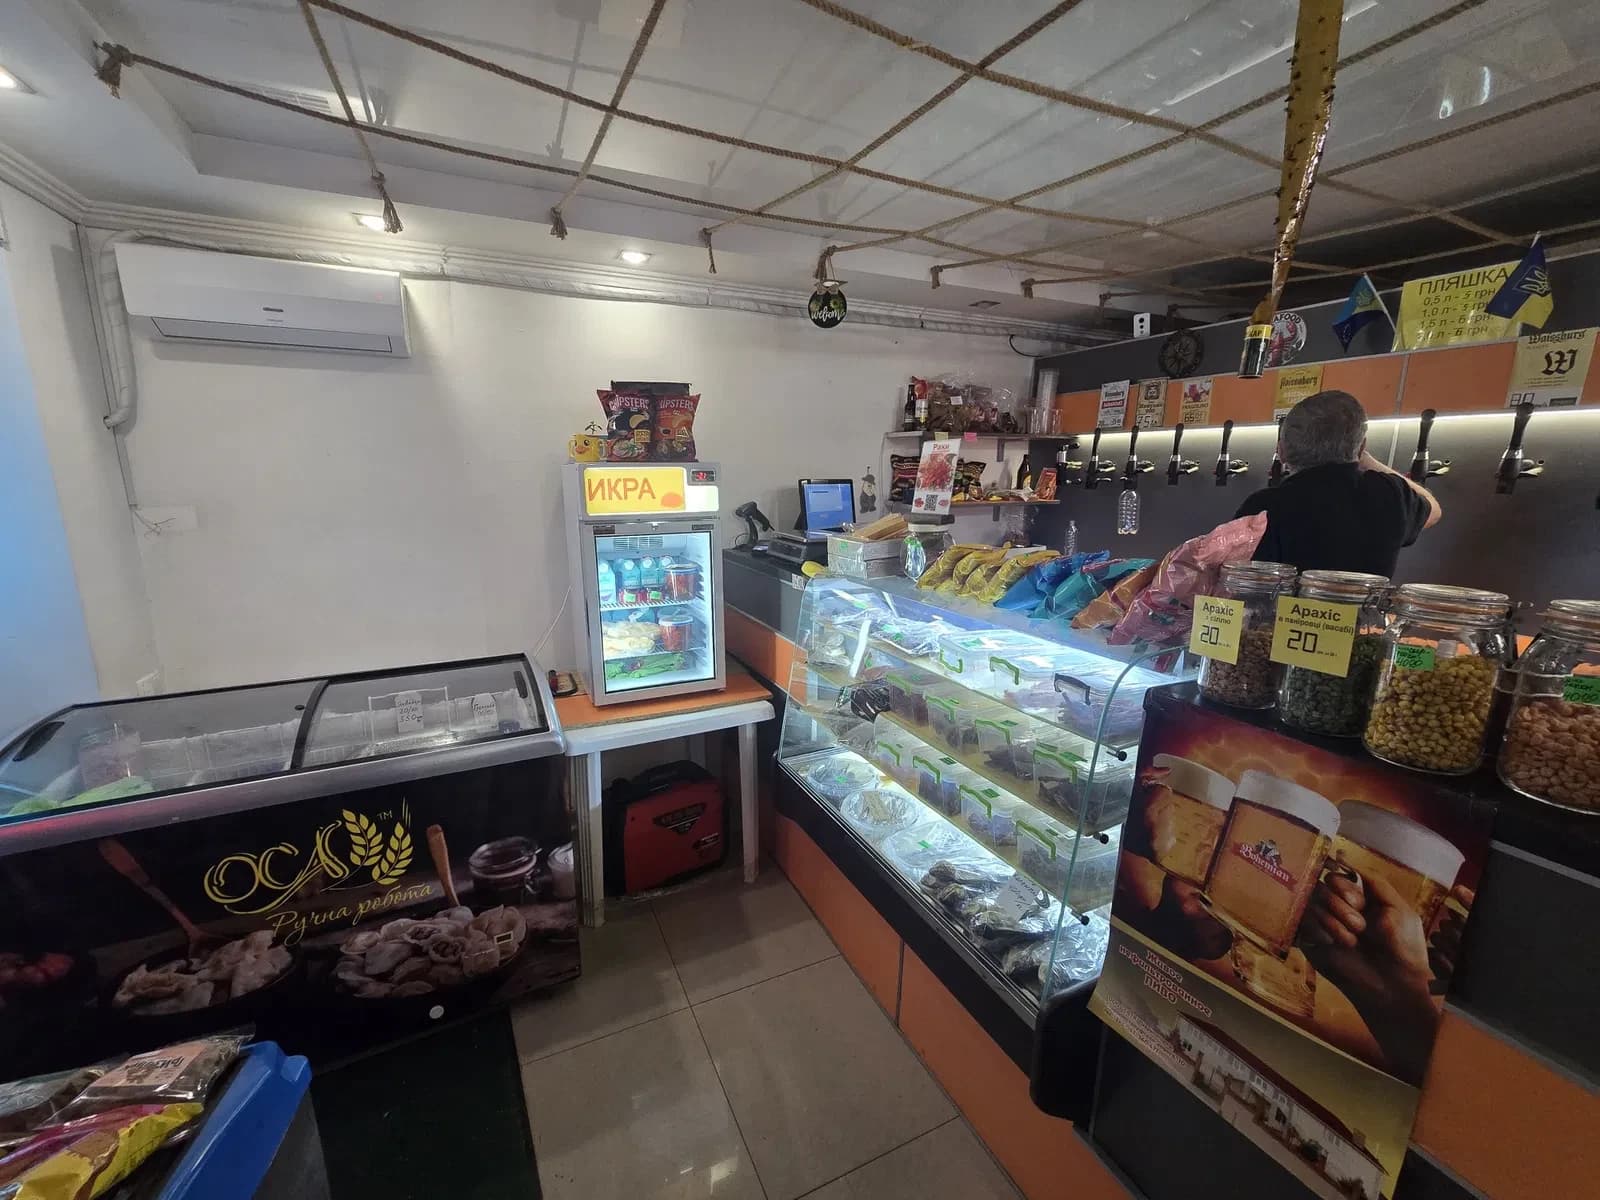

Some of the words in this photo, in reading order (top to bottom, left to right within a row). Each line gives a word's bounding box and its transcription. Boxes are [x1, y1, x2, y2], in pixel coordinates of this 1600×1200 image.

[1419, 267, 1509, 295] ПЛЯШКА
[1472, 301, 1488, 312] гр
[587, 477, 656, 501] ИКРА
[1202, 602, 1234, 617] Арахіс
[1290, 604, 1342, 622] Арахіс
[1200, 624, 1219, 645] 20
[1287, 629, 1318, 653] 20
[1239, 843, 1290, 881] Bohemian
[265, 906, 352, 946] Ручна
[354, 882, 436, 925] робота
[1145, 949, 1184, 983] Живое
[1118, 944, 1214, 1018] нефильтрованное
[1143, 973, 1179, 1005] ПИВО
